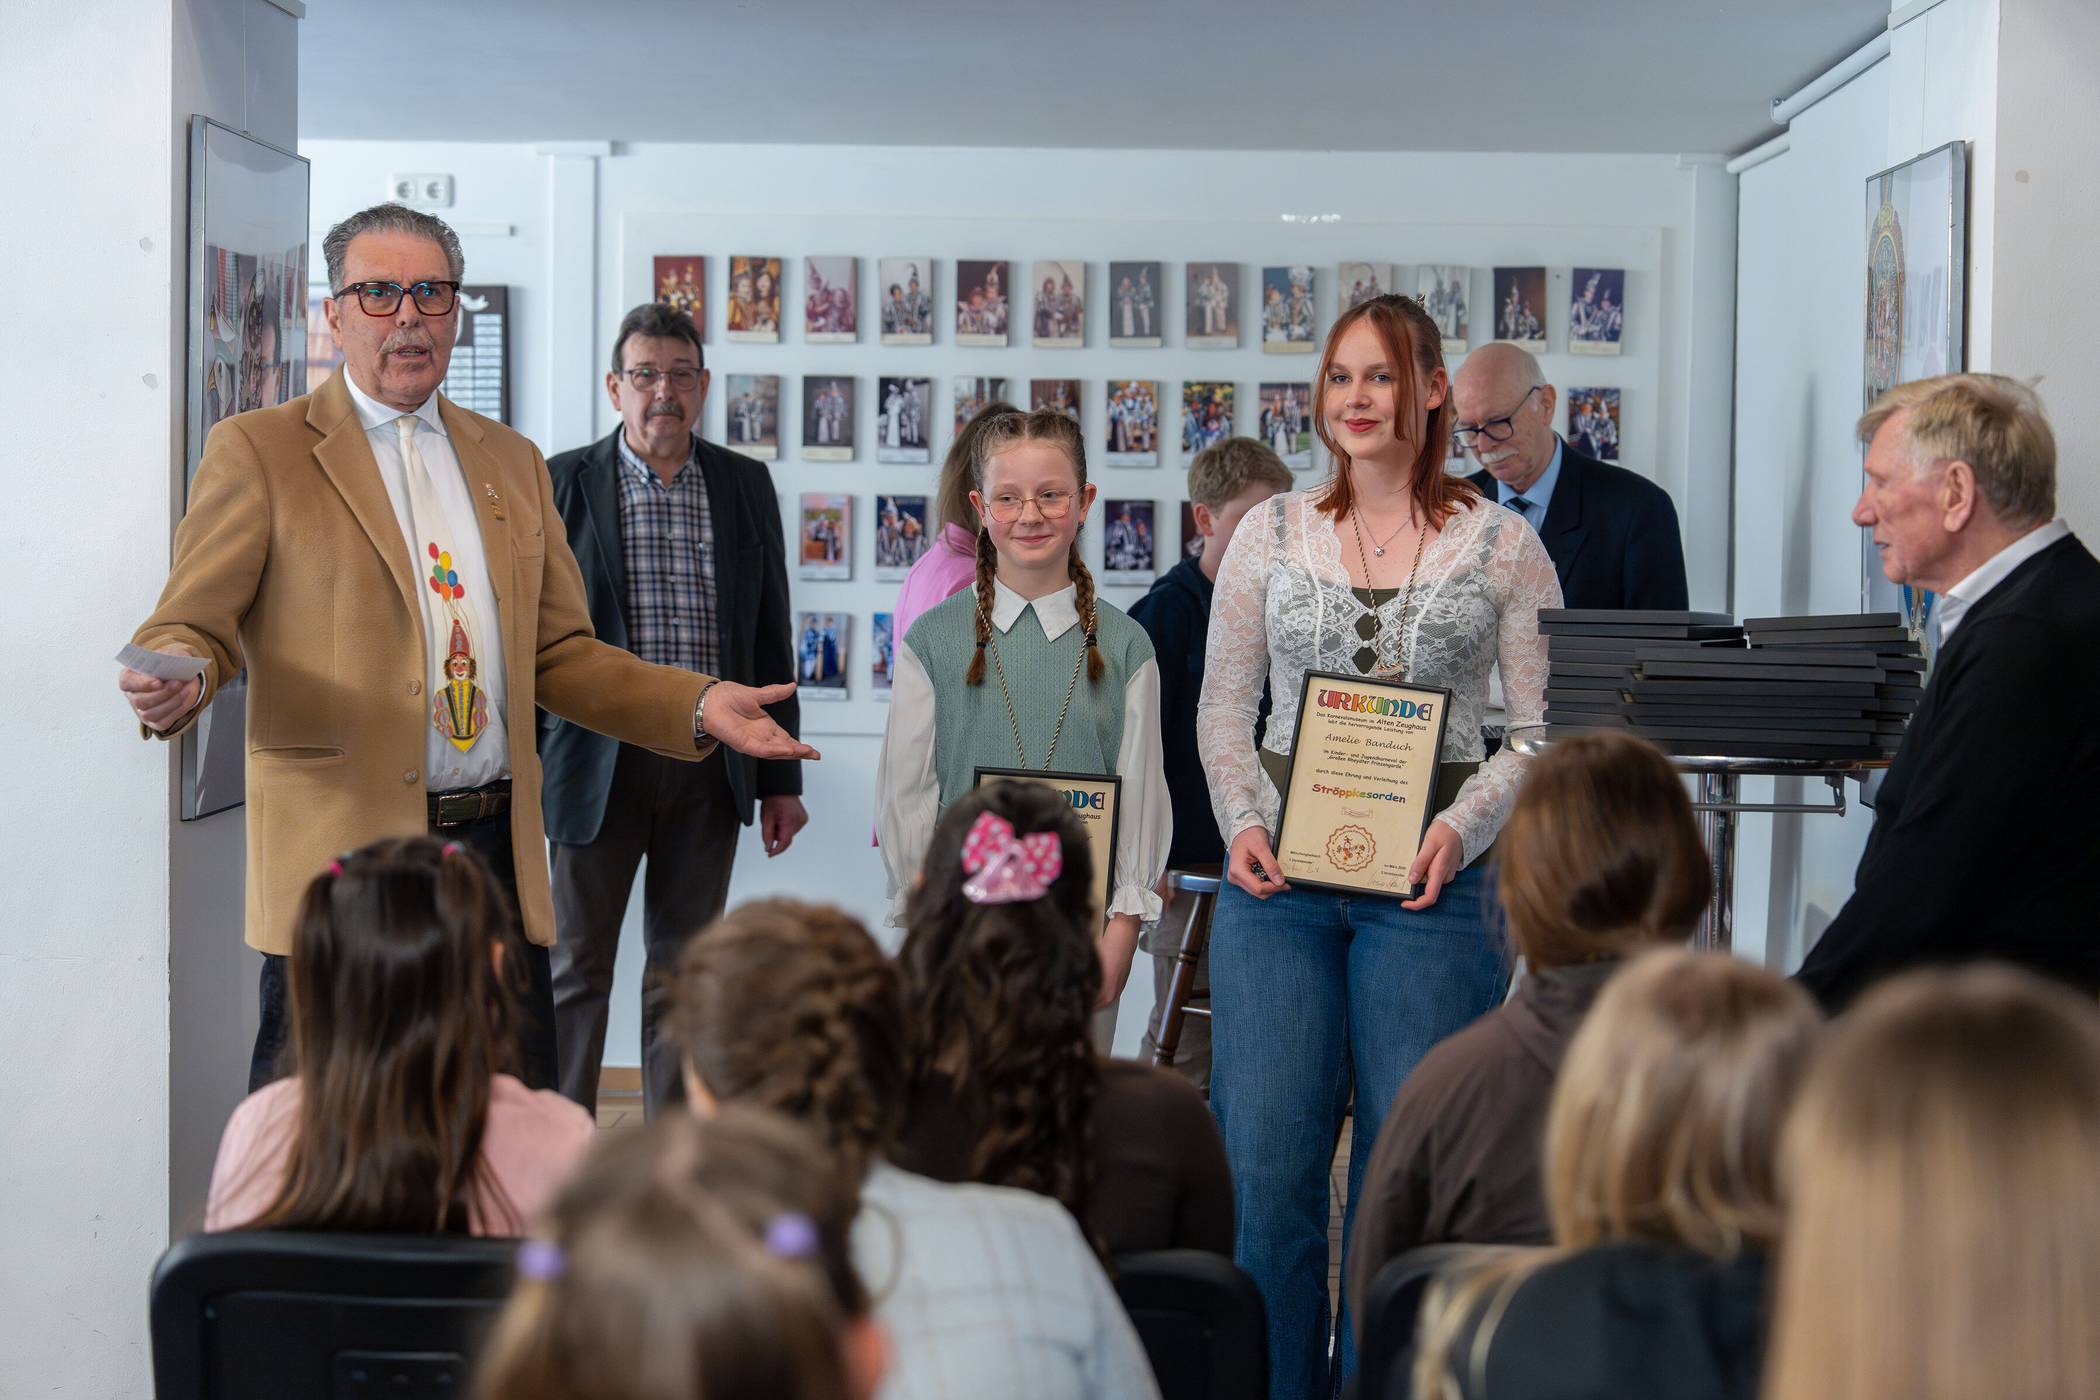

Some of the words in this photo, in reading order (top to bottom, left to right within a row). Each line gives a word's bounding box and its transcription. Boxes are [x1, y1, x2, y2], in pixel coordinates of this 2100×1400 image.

[1318, 689, 1434, 722] URKUNDE
[1376, 719, 1395, 727] Alten
[1395, 721, 1427, 731] Zeughaus
[1325, 733, 1361, 745] Amelie
[1365, 738, 1414, 752] Banduch
[1344, 772, 1361, 780] Ehrung
[1312, 783, 1406, 804] Ströppkesorden
